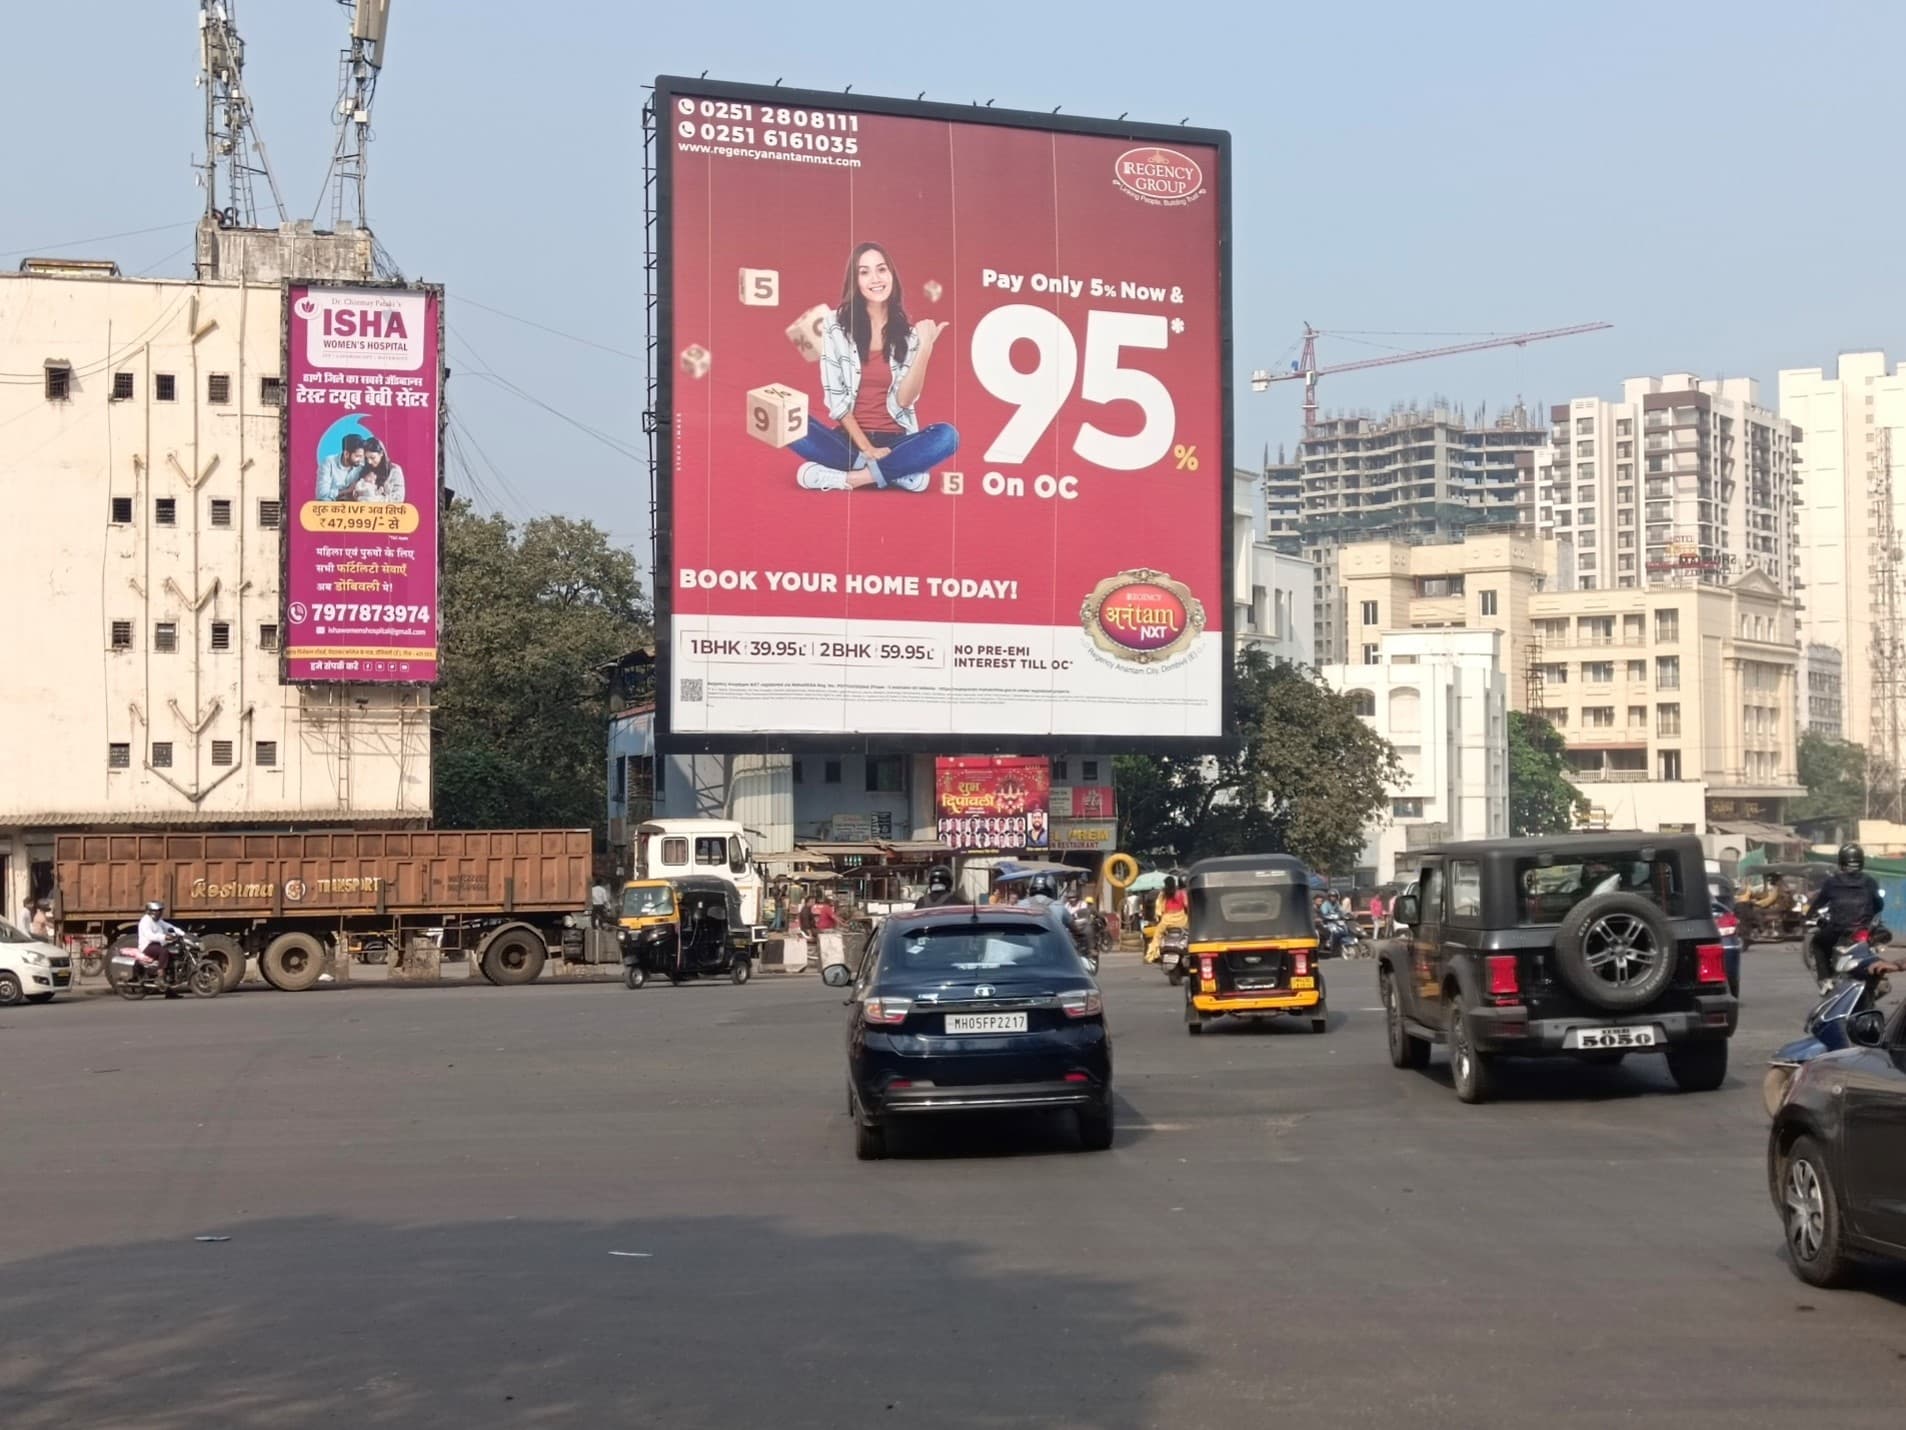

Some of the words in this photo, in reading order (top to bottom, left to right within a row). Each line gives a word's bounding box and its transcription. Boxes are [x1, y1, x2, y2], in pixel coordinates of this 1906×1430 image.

[700, 100, 752, 121] 0251
[761, 107, 859, 132] 2808111
[700, 123, 755, 144] 0251
[763, 129, 858, 154] 6161035
[678, 142, 861, 167] www.regencyanantamnxt.com
[1123, 161, 1194, 180] REGENCY
[1135, 177, 1187, 194] GROUP
[754, 277, 773, 299] 5
[982, 269, 1024, 293] Pay
[1031, 273, 1083, 297] Only
[1091, 278, 1117, 297] 5%
[1120, 281, 1166, 303] Now
[1170, 286, 1184, 304] &
[323, 309, 408, 339] ISHA
[323, 339, 365, 349] WOMEN'S
[367, 342, 408, 352] HOSPITAL
[346, 374, 358, 384] का
[296, 384, 327, 404] टेस्ट
[396, 387, 430, 407] सेंटर
[754, 407, 770, 431] 9
[788, 407, 802, 431] 5
[982, 472, 1024, 496] On
[1034, 474, 1079, 499] OC
[348, 505, 365, 514] IVF
[368, 506, 383, 515] अब
[388, 518, 399, 530] से
[316, 547, 343, 557] महिला
[384, 548, 394, 558] के
[397, 548, 415, 560] लिए
[316, 562, 334, 573] सभी
[316, 583, 332, 591] अब
[679, 569, 757, 590] BOOK
[766, 571, 837, 593] YOUR
[846, 574, 920, 595] HOME
[927, 578, 1018, 600] TODAY!
[312, 603, 430, 623] 7977873974
[1141, 626, 1168, 641] NXT
[954, 645, 974, 655] NO
[977, 645, 1030, 657] PRE-EMI
[954, 657, 1016, 669] INTEREST
[1020, 658, 1047, 670] TILL
[191, 878, 275, 898] Reshma
[954, 1016, 1025, 1030] MH05FP2217
[1582, 1033, 1652, 1047] 5050
